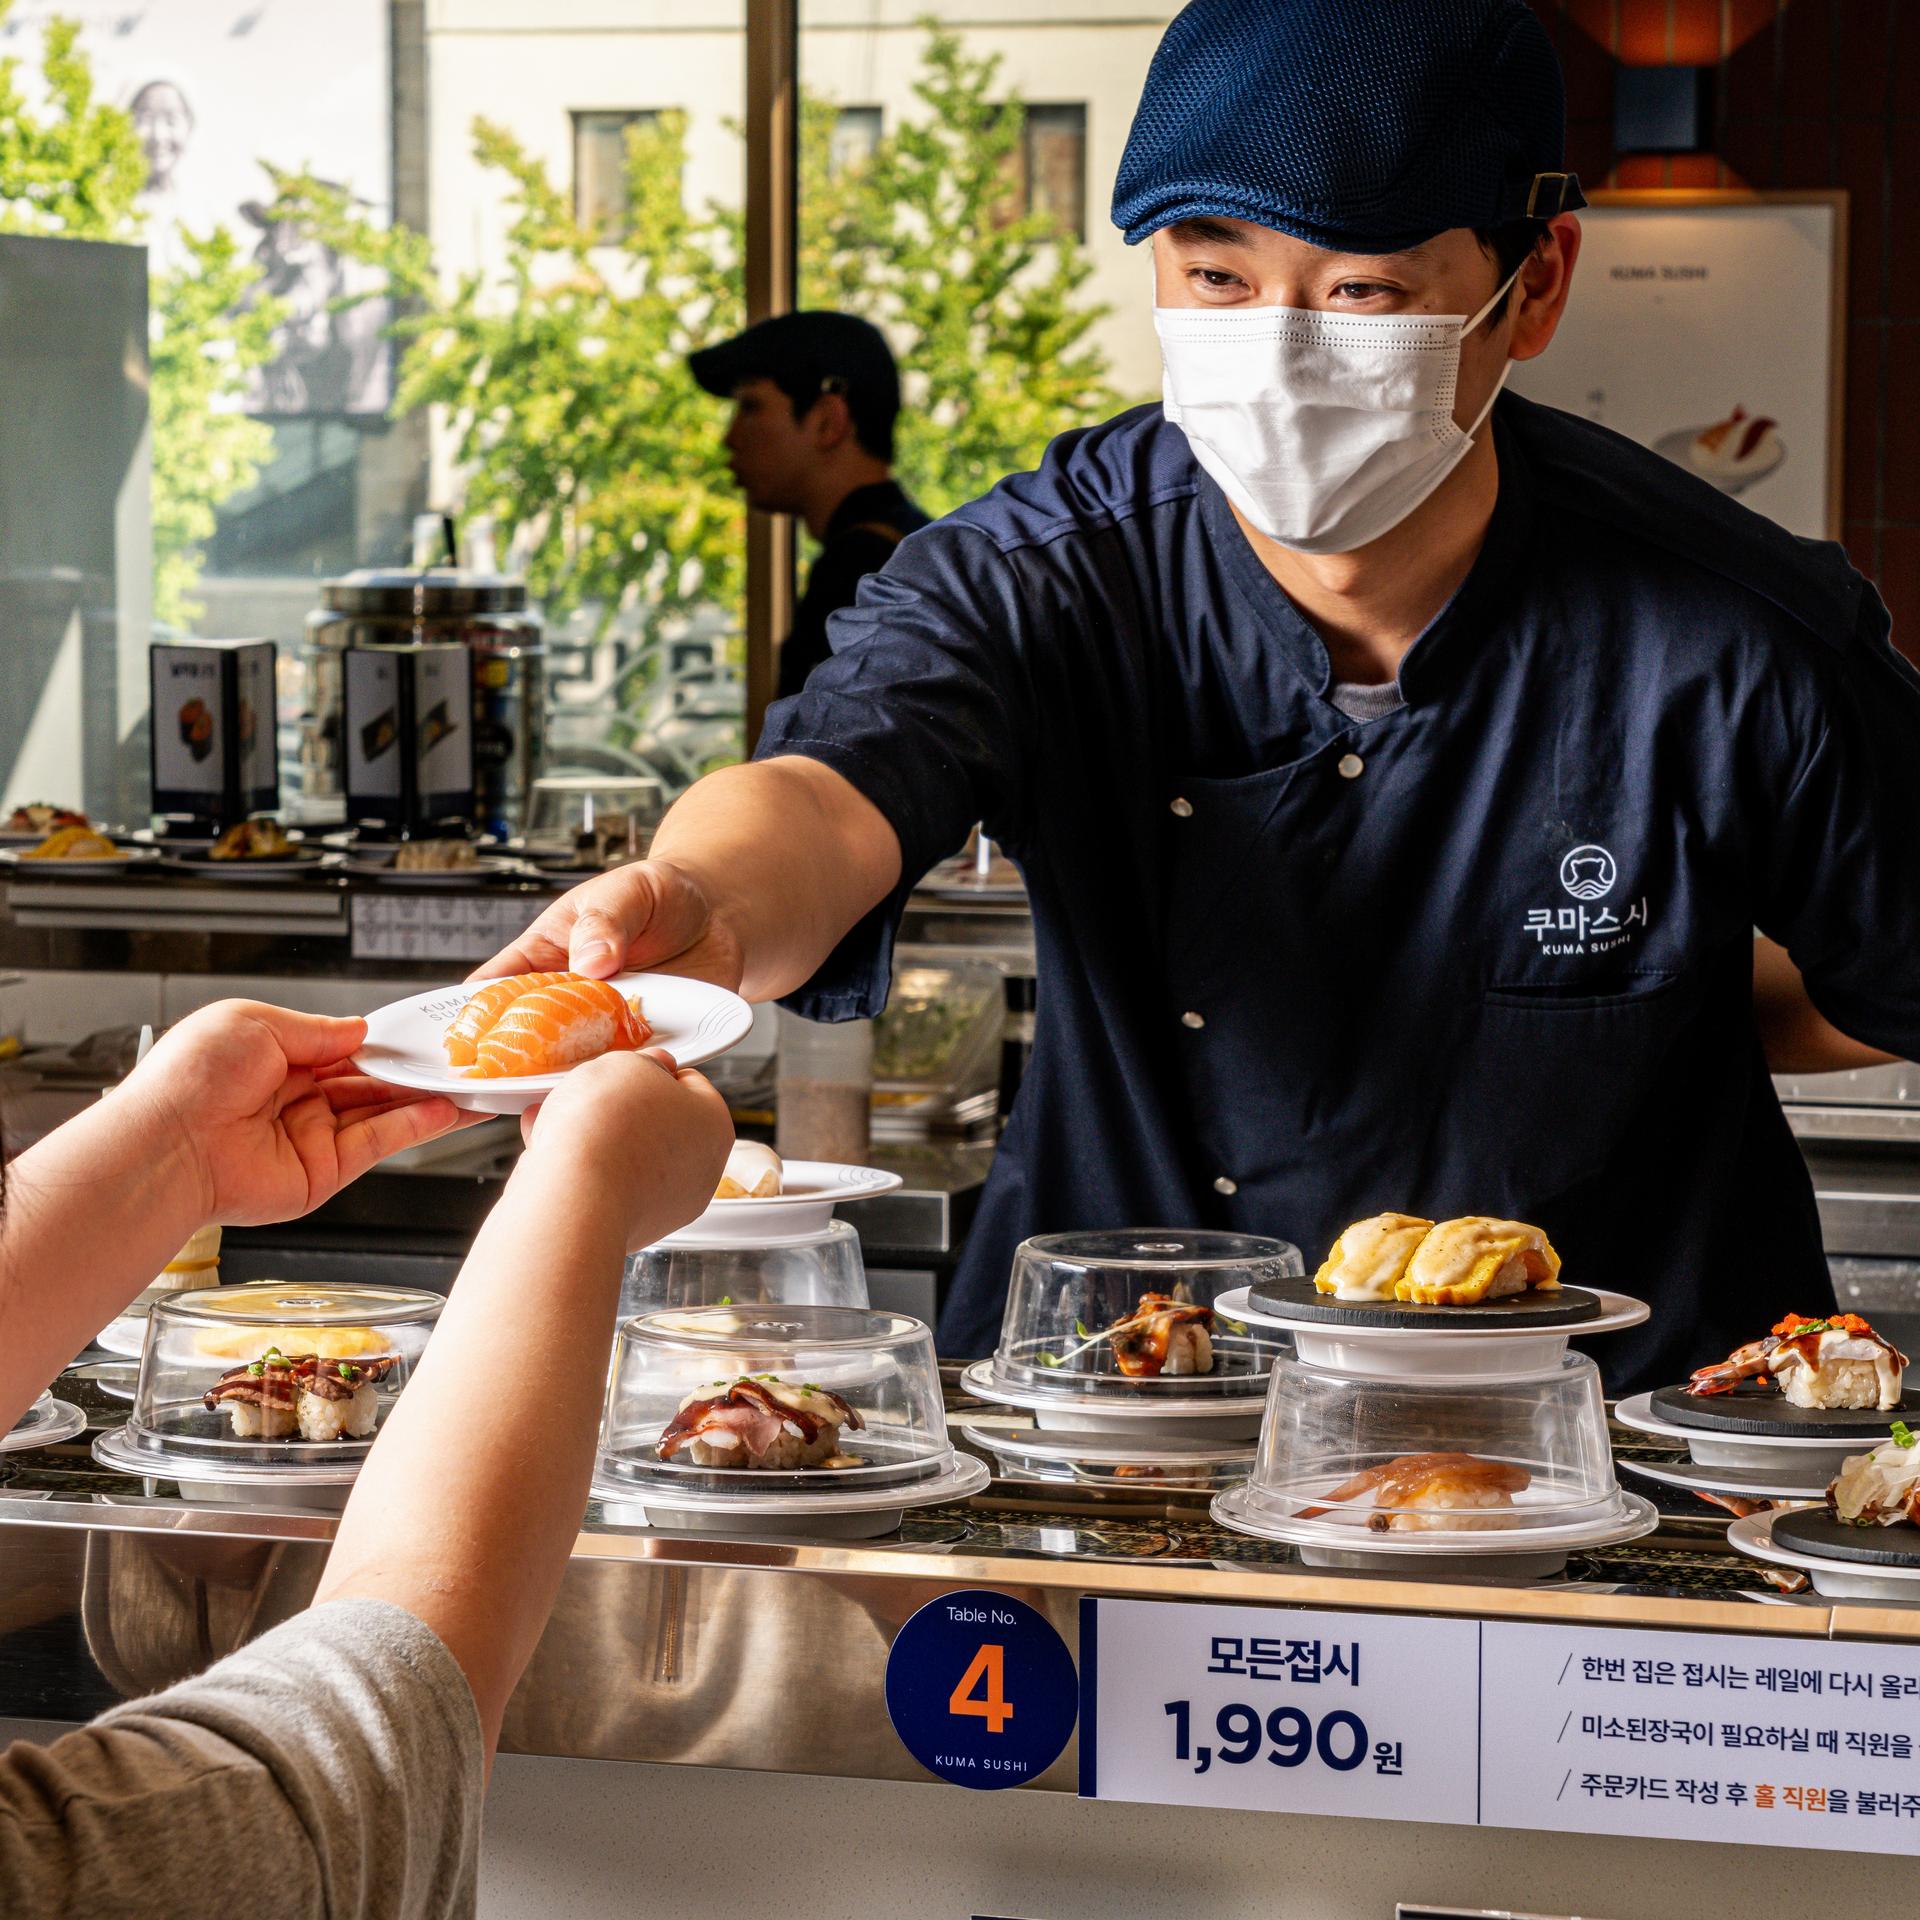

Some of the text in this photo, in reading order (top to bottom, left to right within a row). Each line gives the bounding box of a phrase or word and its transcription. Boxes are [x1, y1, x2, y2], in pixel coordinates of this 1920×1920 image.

[1523, 896, 1648, 942] 쿠마스시
[1542, 942, 1585, 956] KUMA
[946, 1606, 1018, 1626] Table No.
[1207, 1636, 1361, 1687] 모든접시
[1581, 1656, 1626, 1683] 한번
[1631, 1660, 1677, 1686] 집은
[1682, 1662, 1750, 1691] 접시는
[1755, 1667, 1823, 1695] 레일에
[1829, 1671, 1874, 1698] 다시
[949, 1643, 1014, 1733] 4
[1582, 1714, 1914, 1759] 미소된장국이 필요하실 때 직원을
[935, 1755, 1028, 1772] KUMA SUSHI
[1580, 1773, 1670, 1801] 주문카드
[1675, 1779, 1719, 1806] 작성
[1725, 1781, 1749, 1808] 후
[1754, 1783, 1777, 1809] 홀
